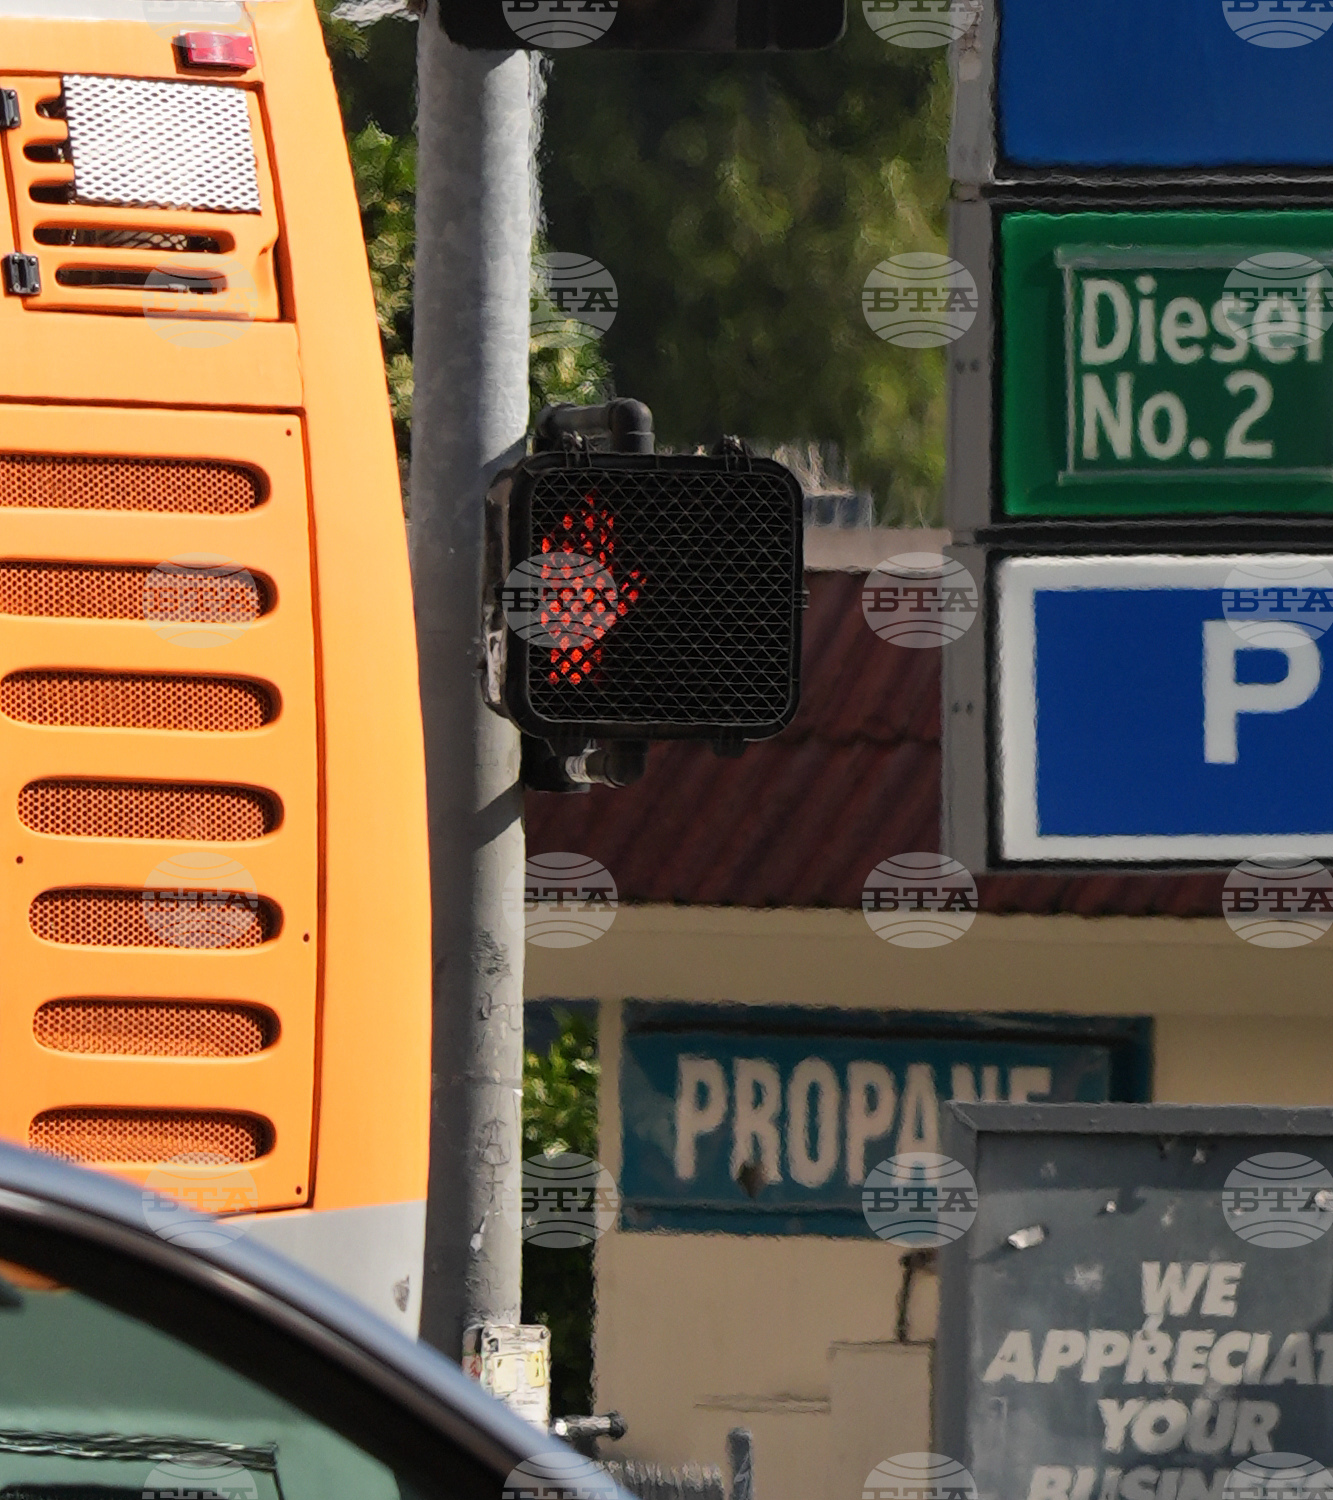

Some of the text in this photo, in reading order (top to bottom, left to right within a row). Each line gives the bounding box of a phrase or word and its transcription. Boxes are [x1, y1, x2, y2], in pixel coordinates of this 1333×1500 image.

[1078, 275, 1328, 365] Diesel
[1141, 1261, 1245, 1317] WE
[1098, 1398, 1281, 1455] YOUR
